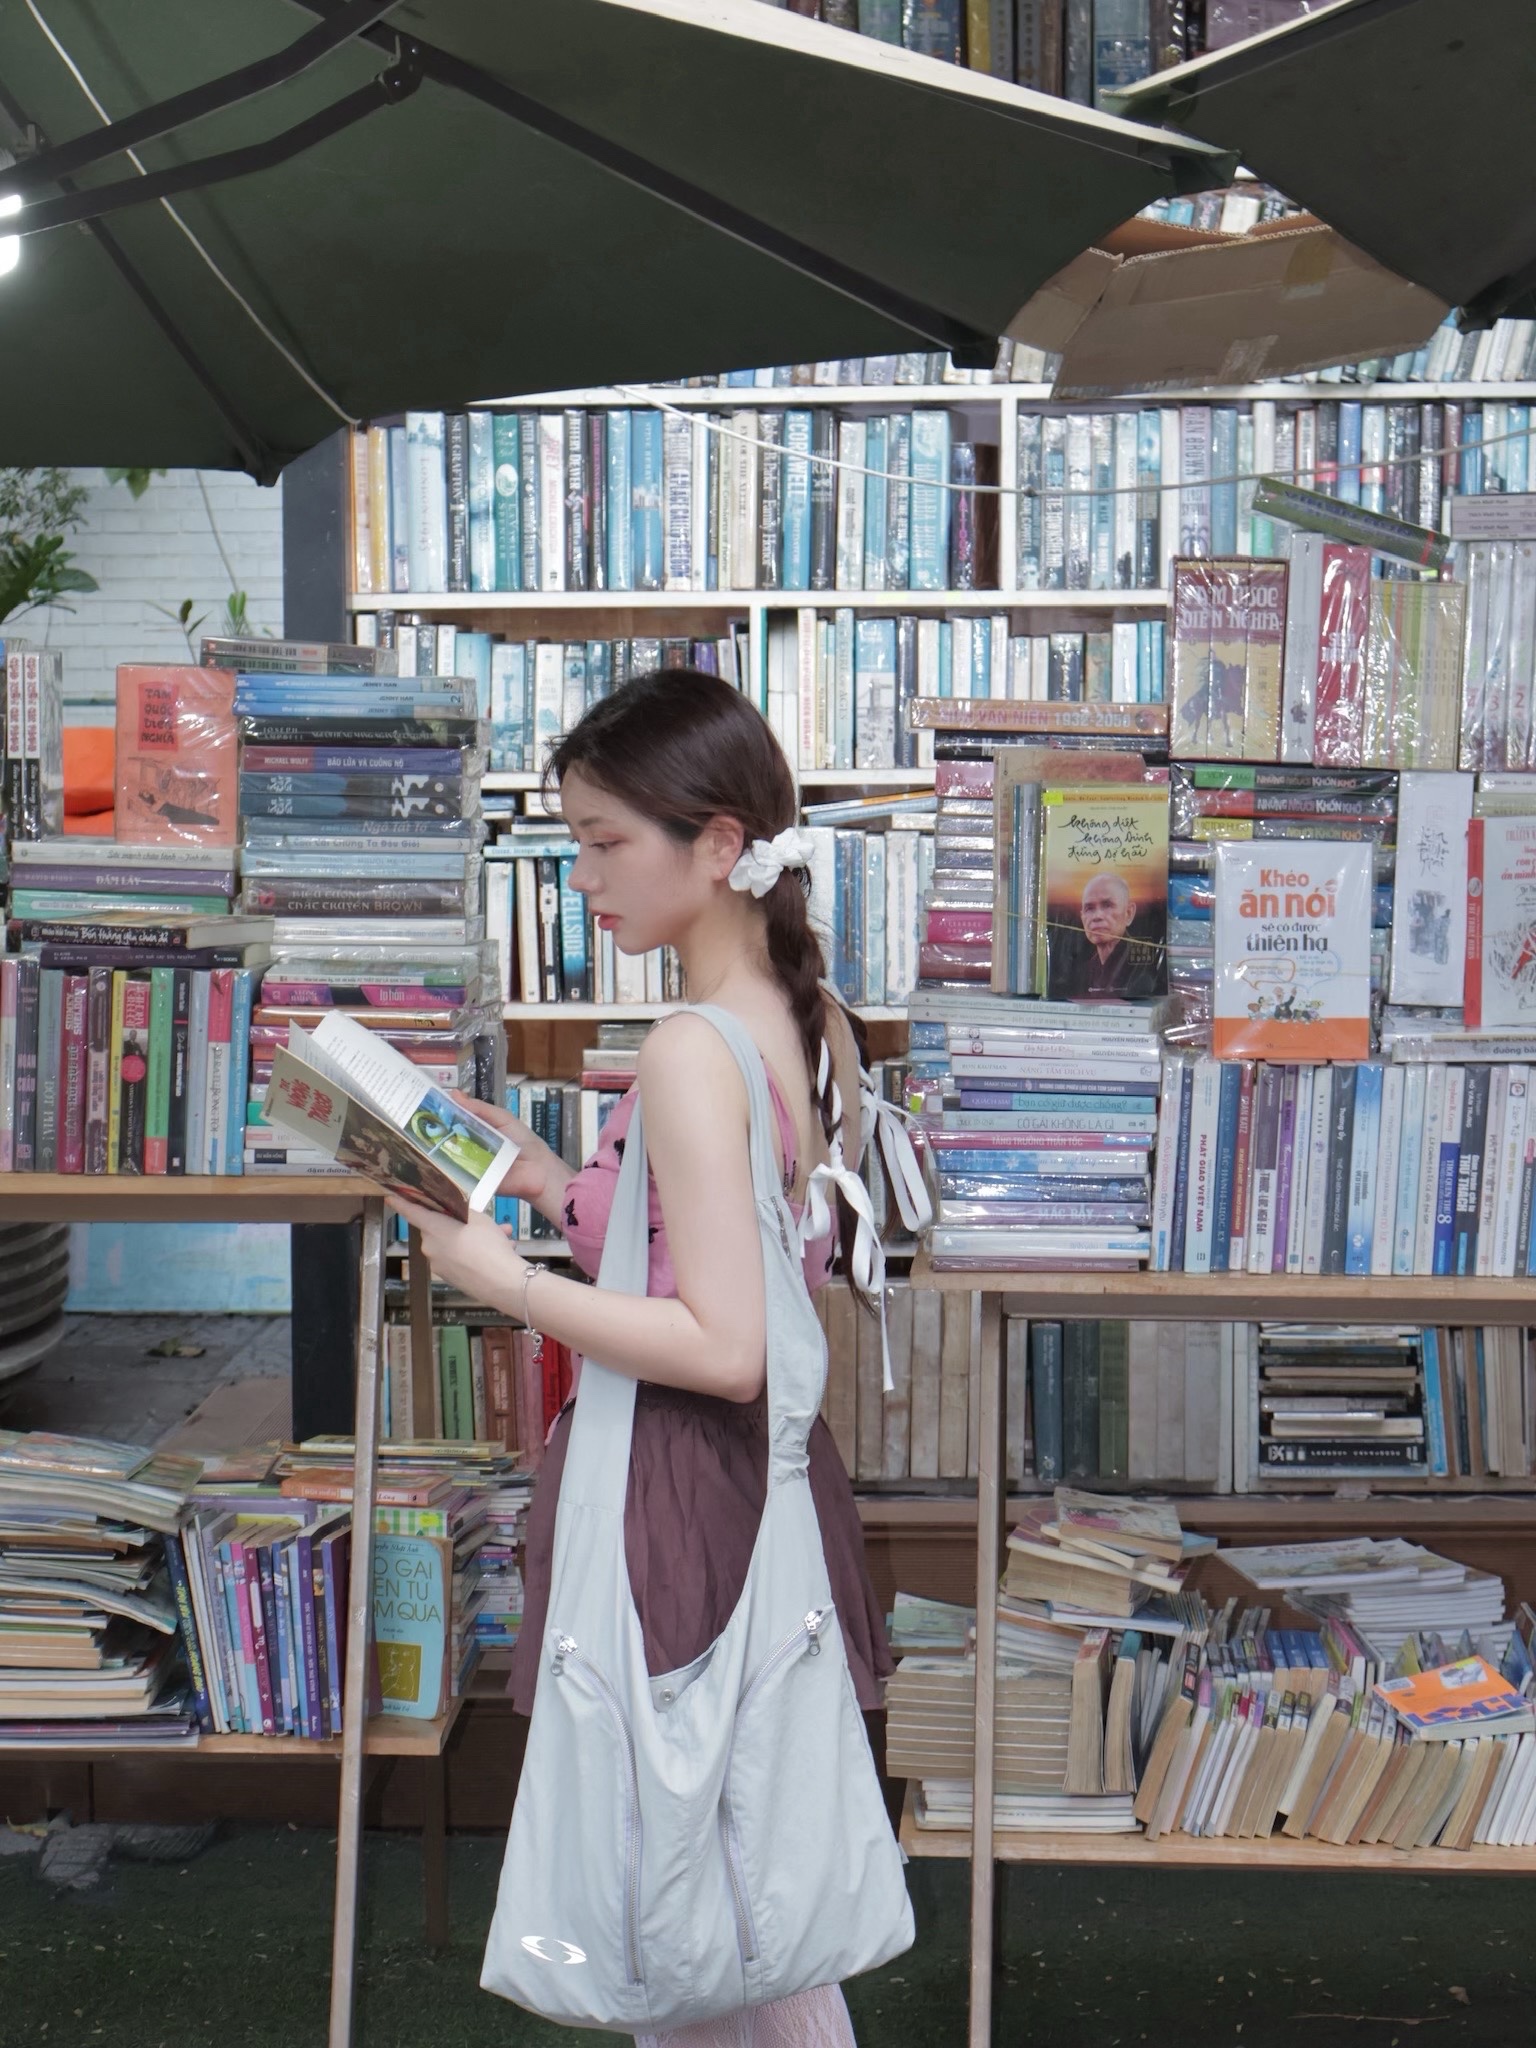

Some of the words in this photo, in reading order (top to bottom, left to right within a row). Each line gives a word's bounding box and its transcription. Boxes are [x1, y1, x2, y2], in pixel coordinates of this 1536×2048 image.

[1260, 868, 1310, 888] Khéo
[1239, 888, 1279, 919] ăn
[1246, 932, 1299, 952] thiên
[1302, 932, 1329, 954] hạ
